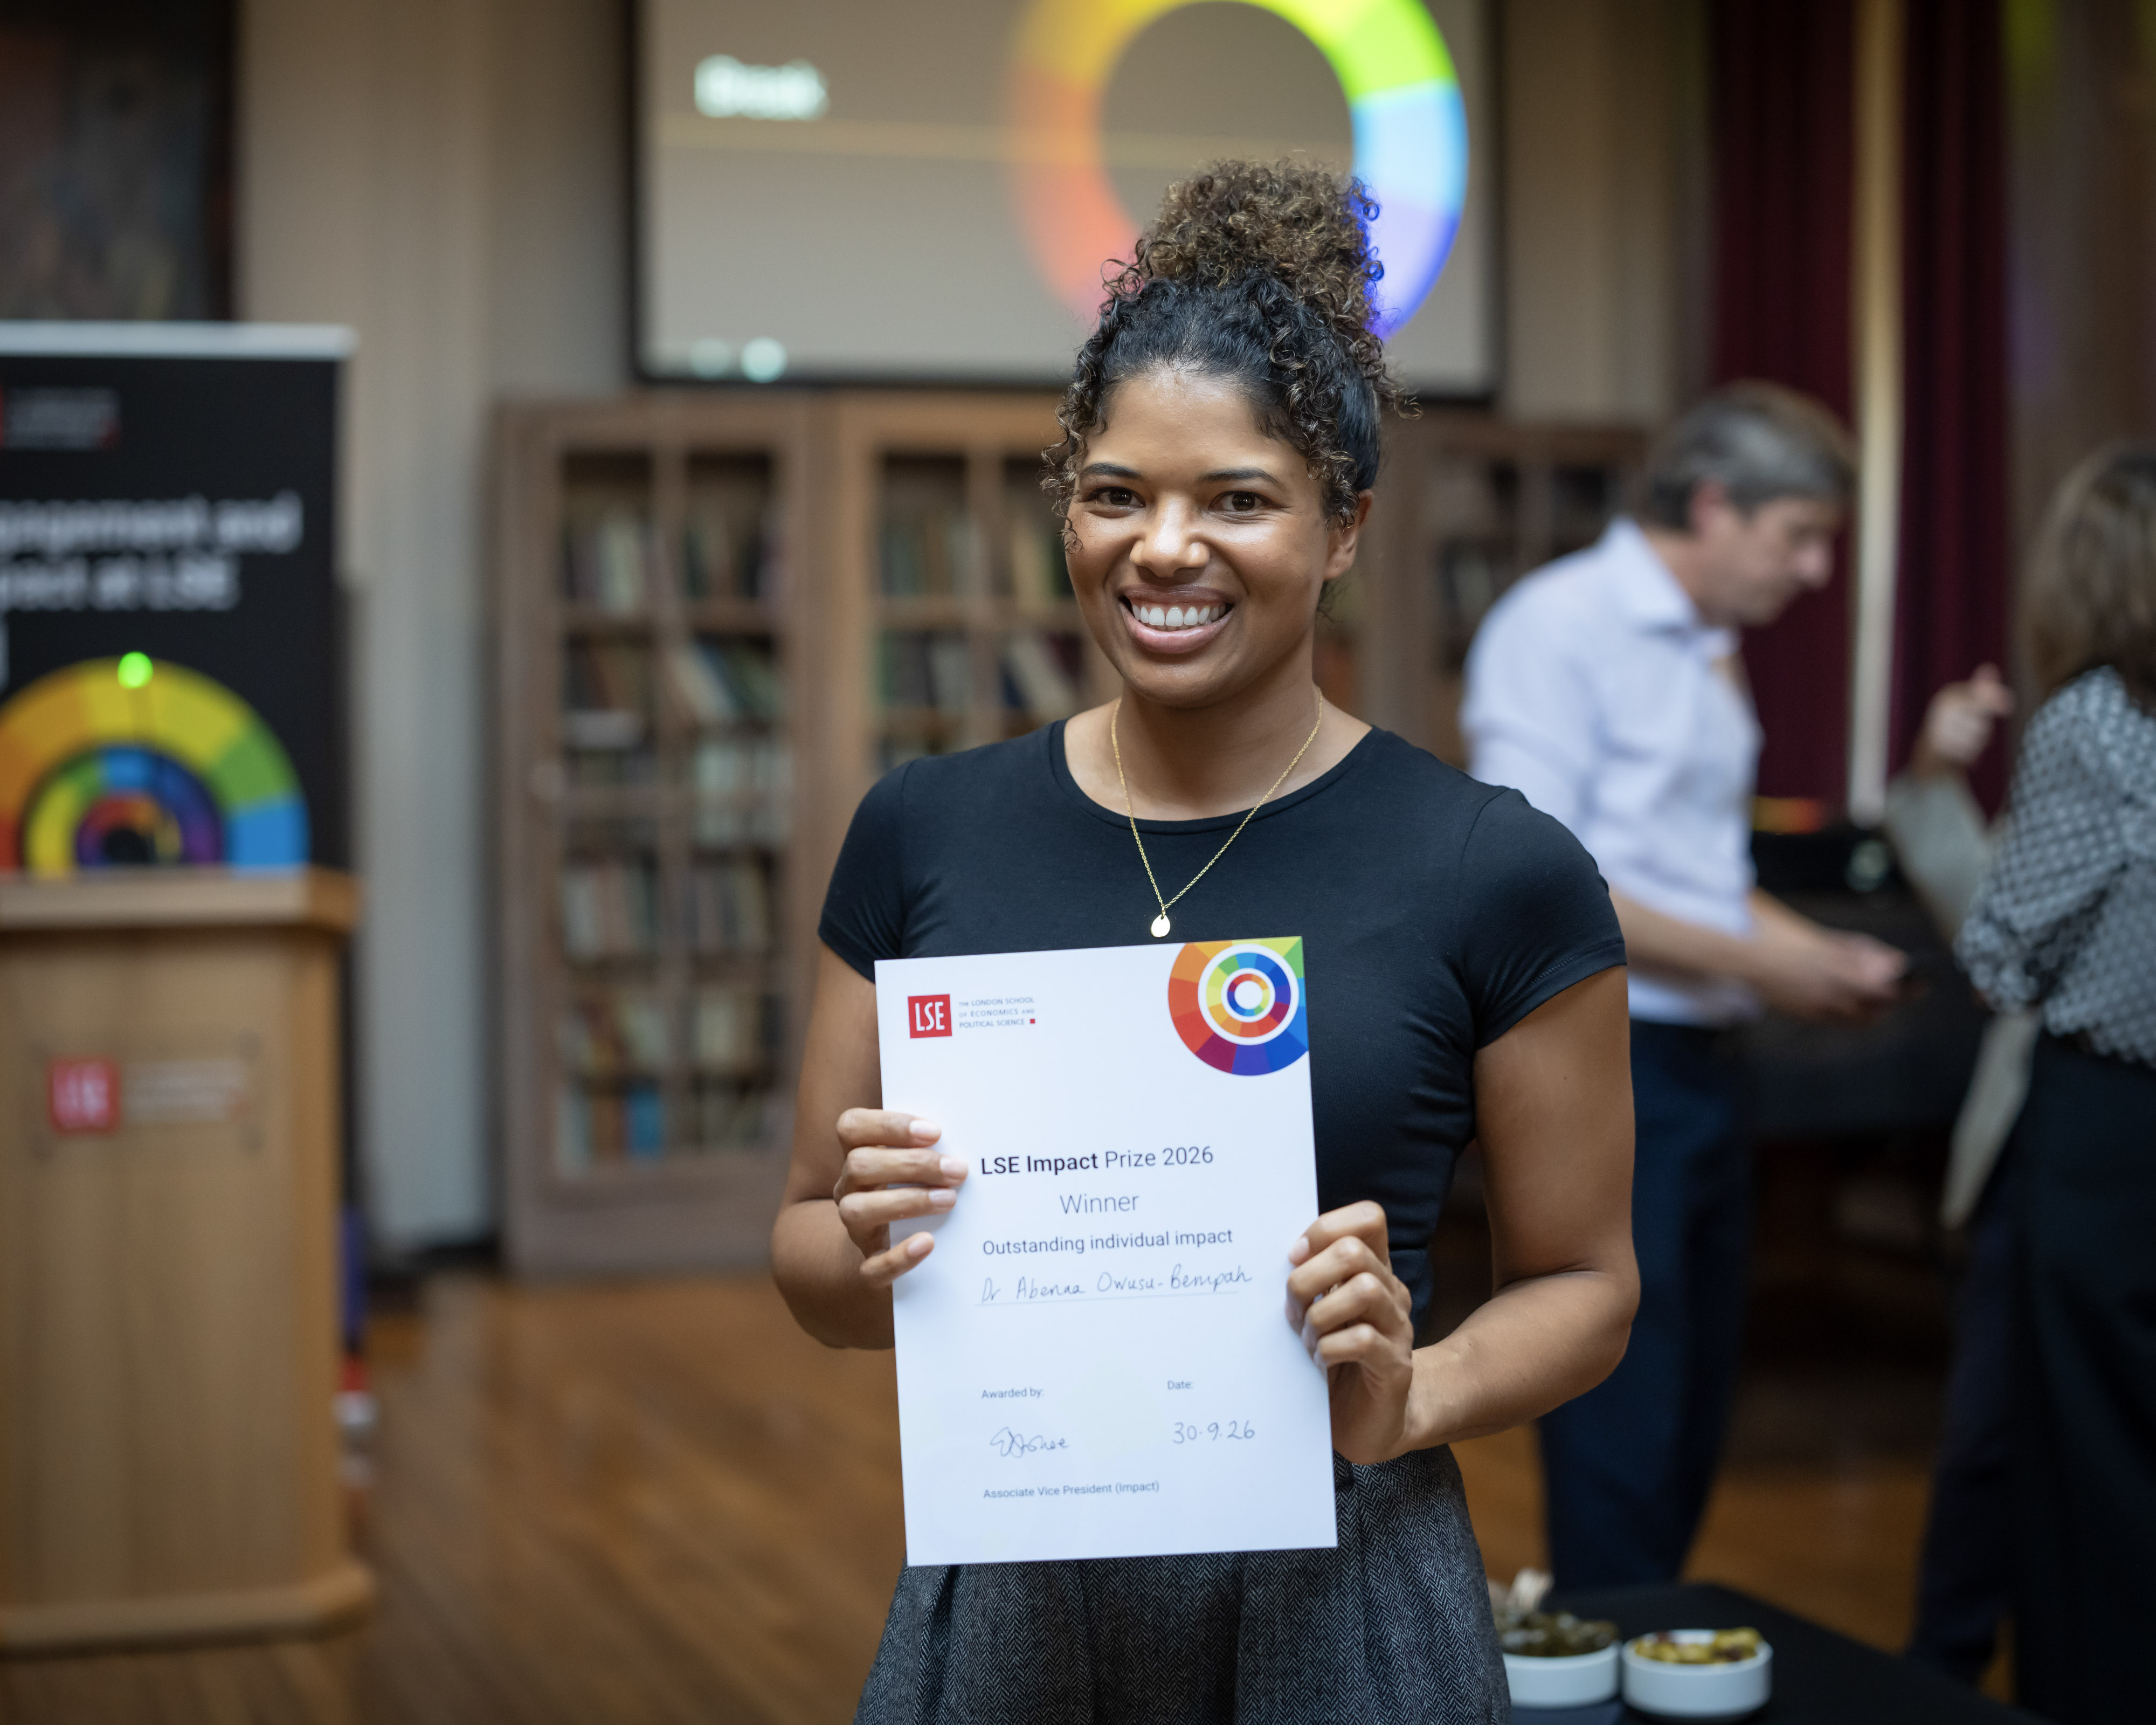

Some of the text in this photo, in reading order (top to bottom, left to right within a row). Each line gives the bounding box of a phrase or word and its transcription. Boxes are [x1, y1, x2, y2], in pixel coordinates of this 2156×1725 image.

[971, 998, 1003, 1006] LONDON
[1005, 996, 1034, 1004] SCHOOL
[915, 1001, 945, 1031] LSE
[971, 1008, 1018, 1017] ECONOMICS
[997, 1018, 1025, 1026] SCIENCE
[980, 1146, 1214, 1175] LSE Impact Prize 2026
[1060, 1193, 1139, 1214] Winner
[983, 1230, 1233, 1255] Outstanding individual impact
[980, 1276, 1001, 1304] Dr
[1016, 1275, 1085, 1300] Abenaa
[981, 1388, 1027, 1398] Awarded
[984, 1480, 1160, 1499] Associate Vice President (Impact)
